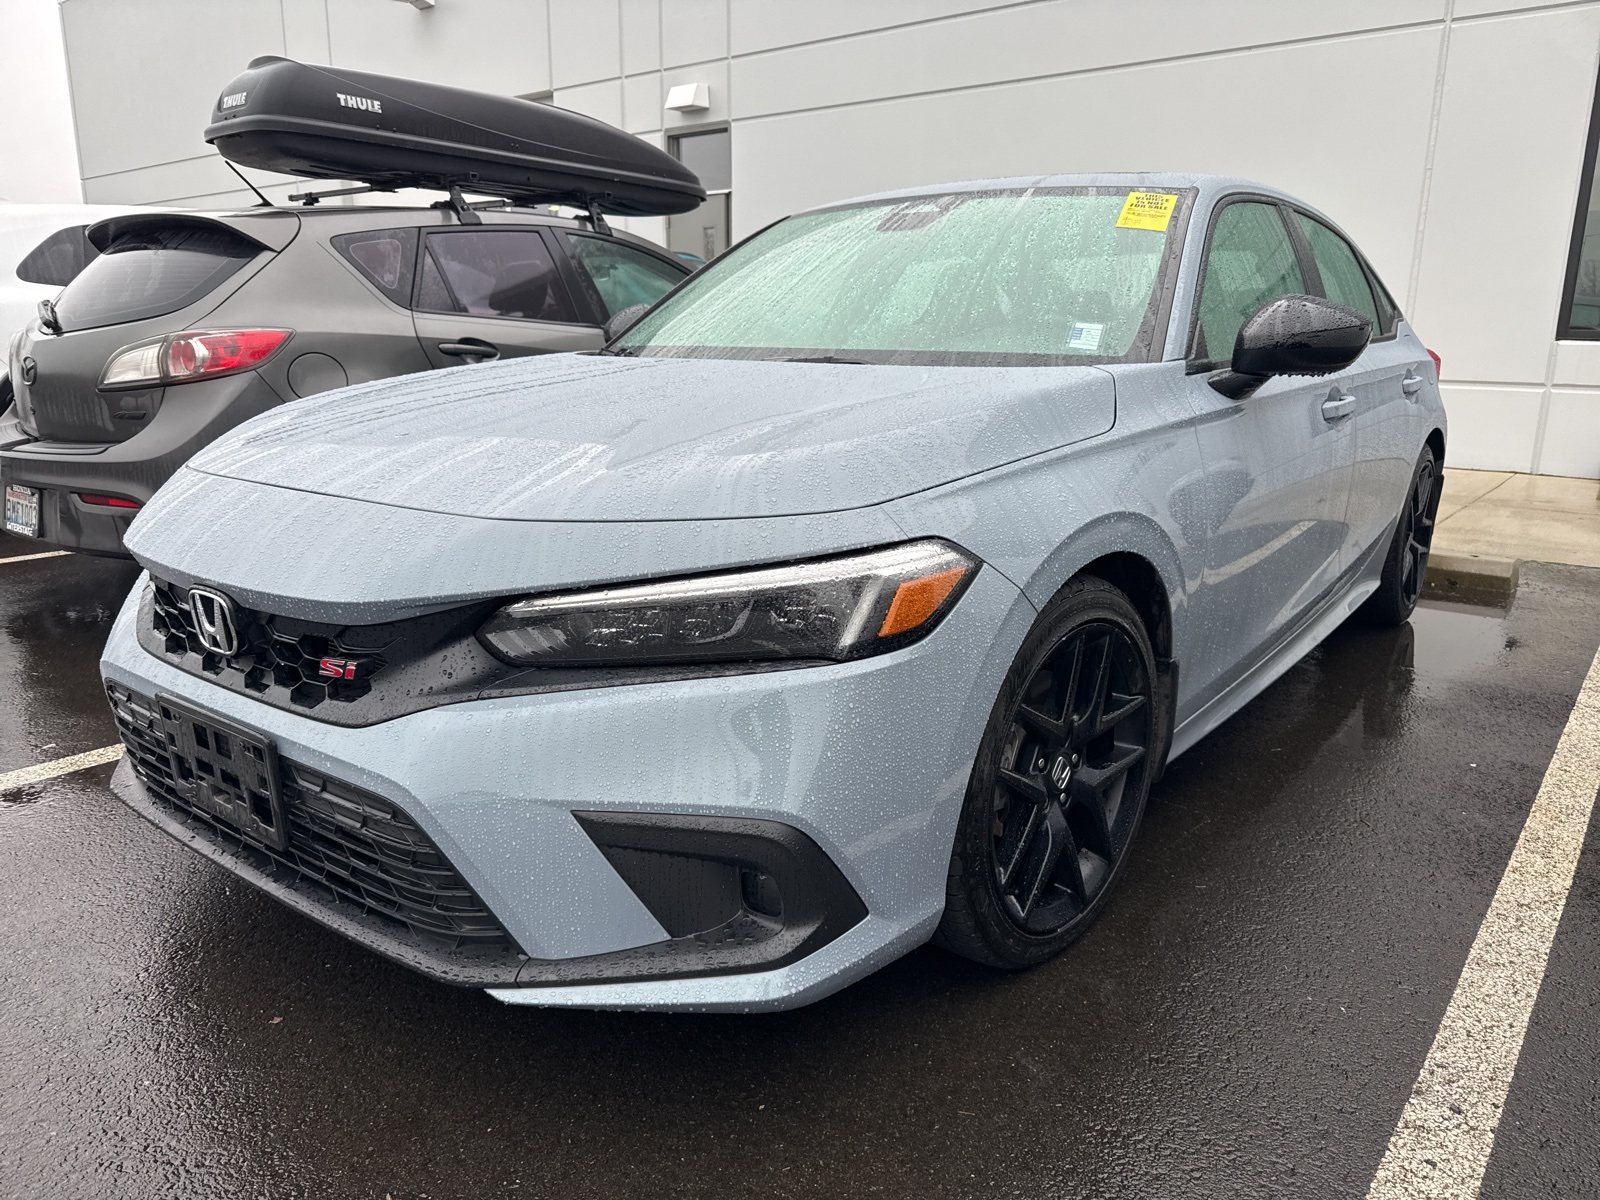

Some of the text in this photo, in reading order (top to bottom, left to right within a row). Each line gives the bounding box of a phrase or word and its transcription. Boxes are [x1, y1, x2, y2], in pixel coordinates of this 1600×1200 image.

[223, 92, 247, 109] THULE
[336, 93, 383, 114] THULE
[12, 484, 31, 495] HONDA
[7, 522, 33, 536] INTERSTATE
[318, 659, 357, 680] Si
